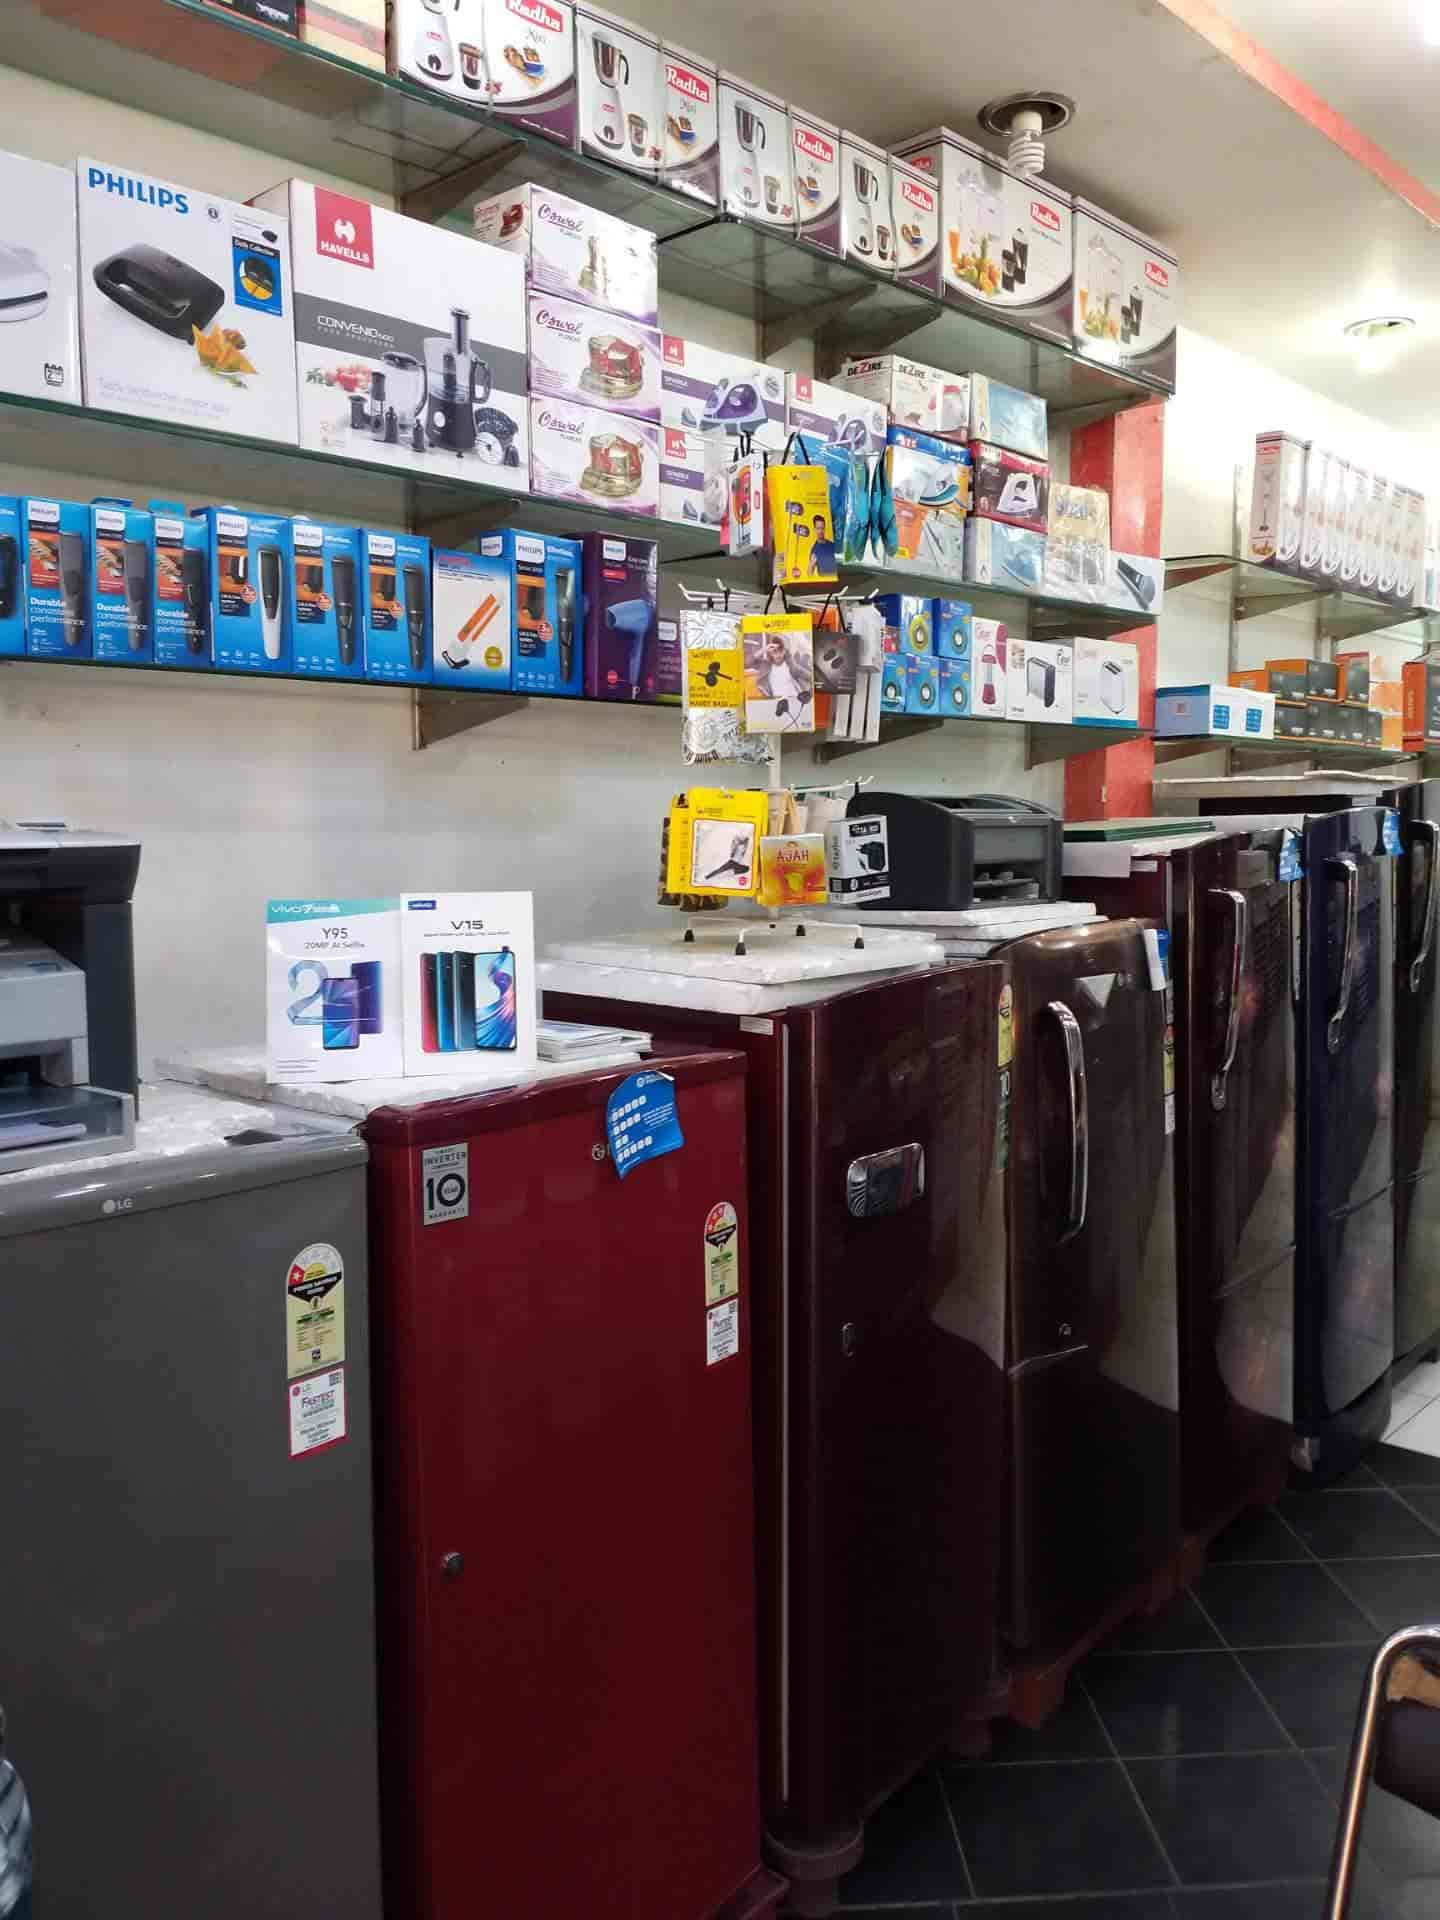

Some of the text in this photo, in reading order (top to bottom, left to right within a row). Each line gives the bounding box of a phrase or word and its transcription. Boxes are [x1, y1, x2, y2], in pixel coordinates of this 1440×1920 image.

[510, 0, 561, 31] Radha
[667, 65, 710, 100] Radha
[797, 131, 833, 162] Radha
[88, 167, 190, 215] PHILIPS
[903, 182, 933, 211] Radha
[537, 203, 584, 233] Oswal
[1032, 205, 1060, 230] Radha
[320, 240, 370, 264] HAVELLS
[536, 309, 584, 335] Oswal
[537, 411, 585, 434] Oswal
[517, 543, 543, 556] PHILIPS
[322, 927, 348, 939] Y95
[450, 920, 484, 930] V15
[424, 1151, 466, 1167] INVERTER
[117, 1198, 133, 1210] LG
[426, 1173, 466, 1211] 10
